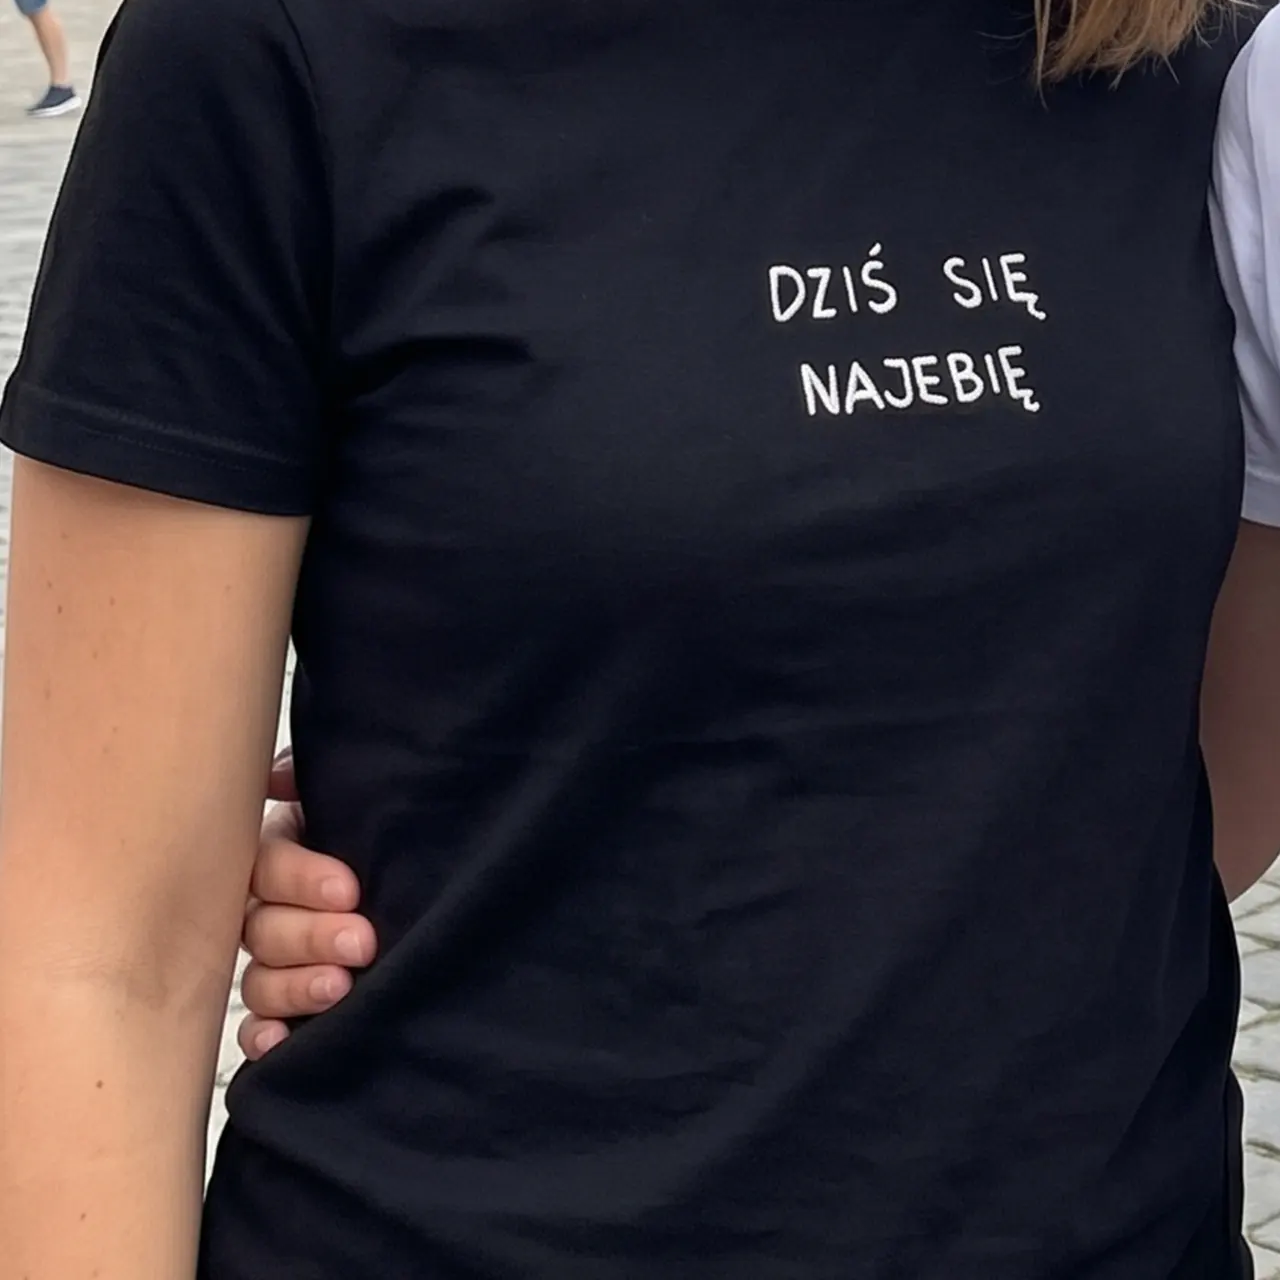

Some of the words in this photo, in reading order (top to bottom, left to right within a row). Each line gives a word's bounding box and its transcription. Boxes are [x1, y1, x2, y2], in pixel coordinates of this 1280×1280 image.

[767, 241, 898, 323] DZIŚ
[942, 252, 1048, 321] SIĘ
[799, 344, 1041, 417] NAJEBIĘ
